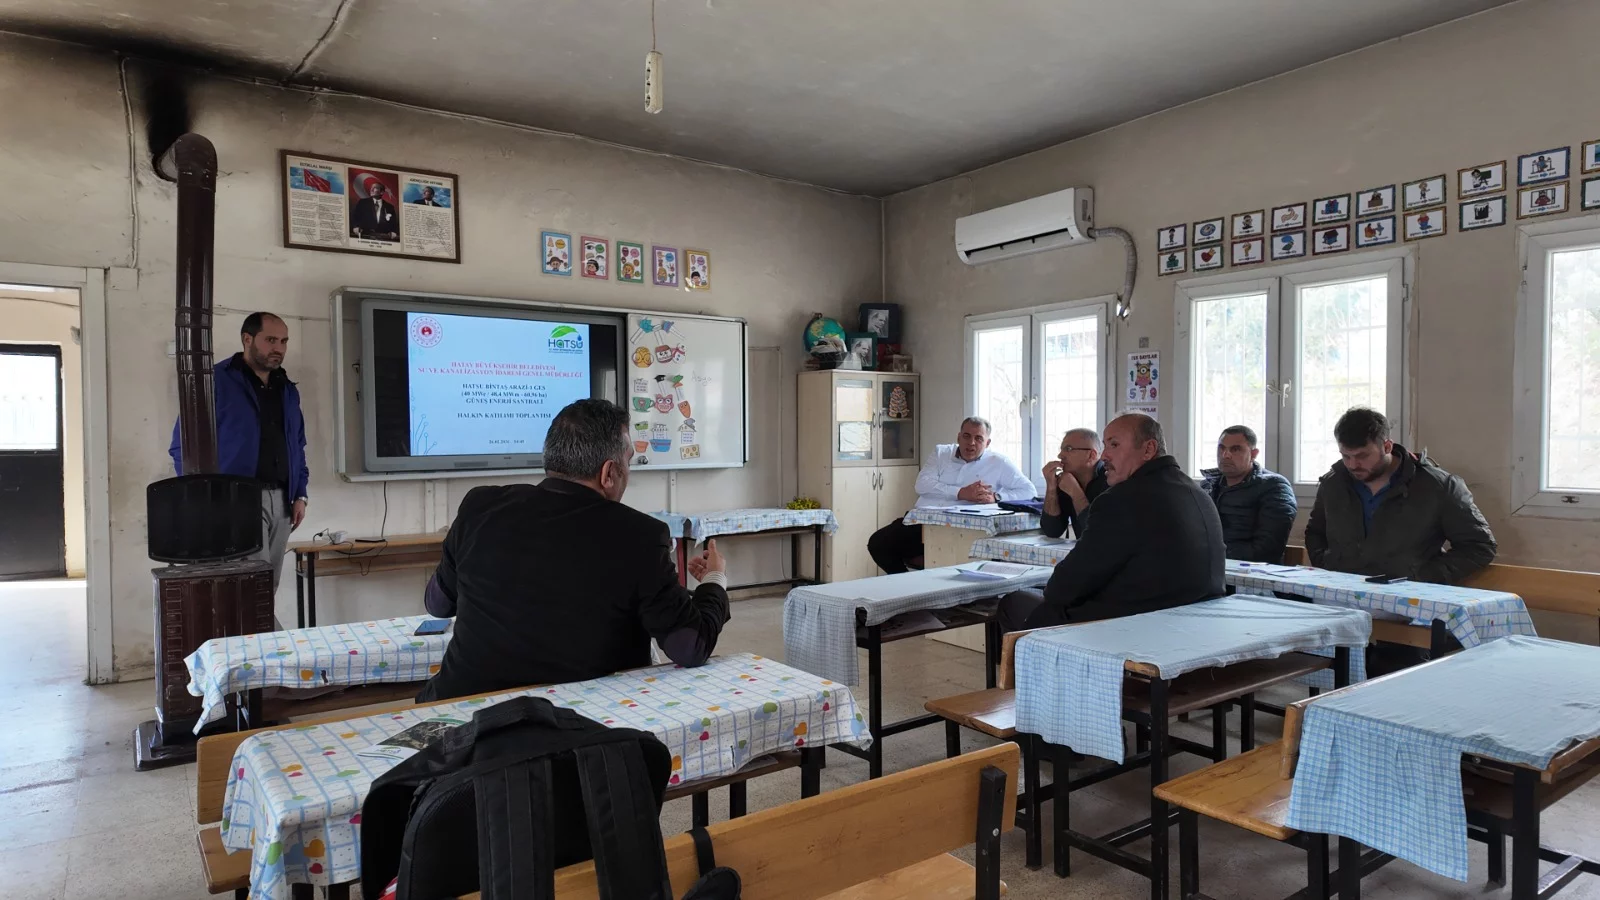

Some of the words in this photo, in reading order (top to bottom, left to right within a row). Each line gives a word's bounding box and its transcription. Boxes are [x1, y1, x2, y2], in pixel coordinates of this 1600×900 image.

[440, 367, 494, 376] KANALİZASYON
[1130, 370, 1134, 381] 1
[1152, 369, 1158, 380] 3
[1130, 388, 1136, 399] 5
[1140, 388, 1146, 400] 7
[465, 397, 488, 405] GÜNEŞ
